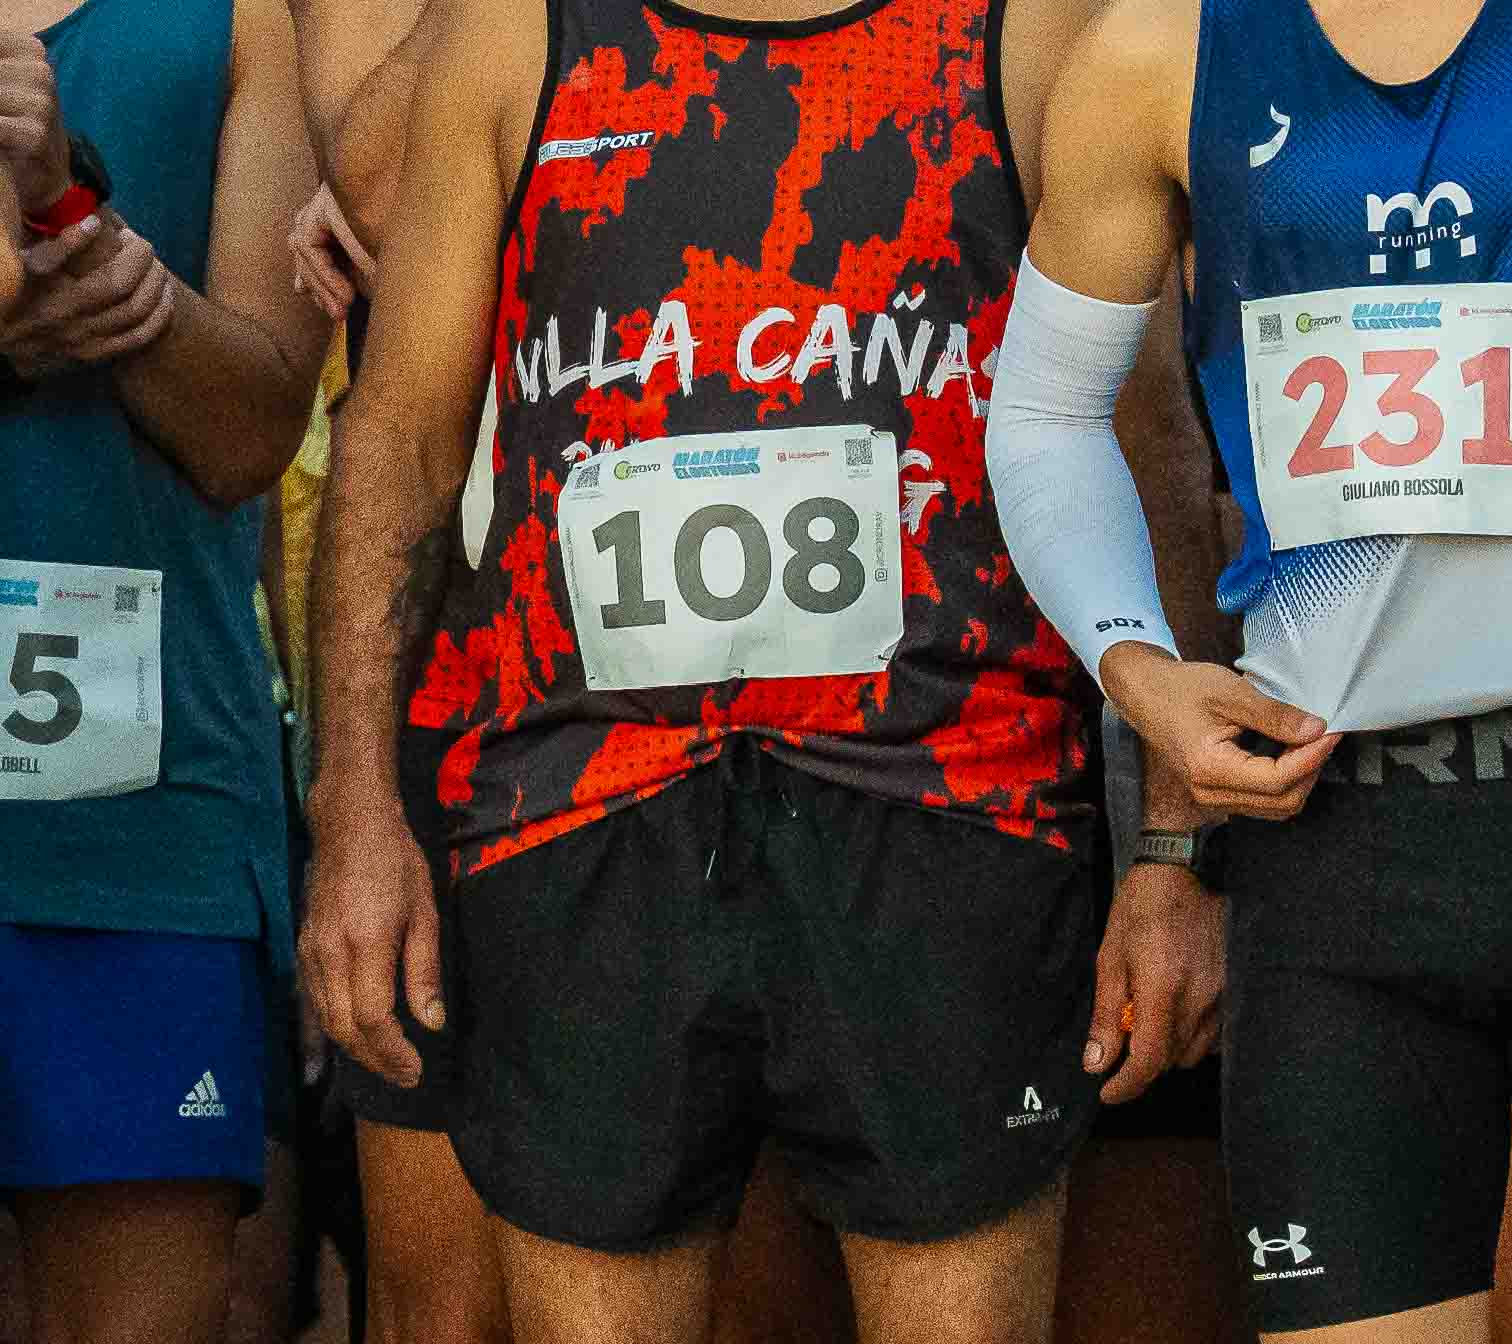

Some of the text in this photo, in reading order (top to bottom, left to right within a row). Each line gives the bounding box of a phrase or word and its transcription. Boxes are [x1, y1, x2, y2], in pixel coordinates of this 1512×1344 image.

[1379, 219, 1464, 254] running
[736, 287, 996, 418] CAÑA
[1342, 478, 1465, 502] GIULIANO BOSSOLA
[591, 496, 866, 630] 108
[1095, 617, 1146, 633] SOX
[179, 1102, 225, 1117] adidas
[1278, 1266, 1325, 1279] ARMOUR
